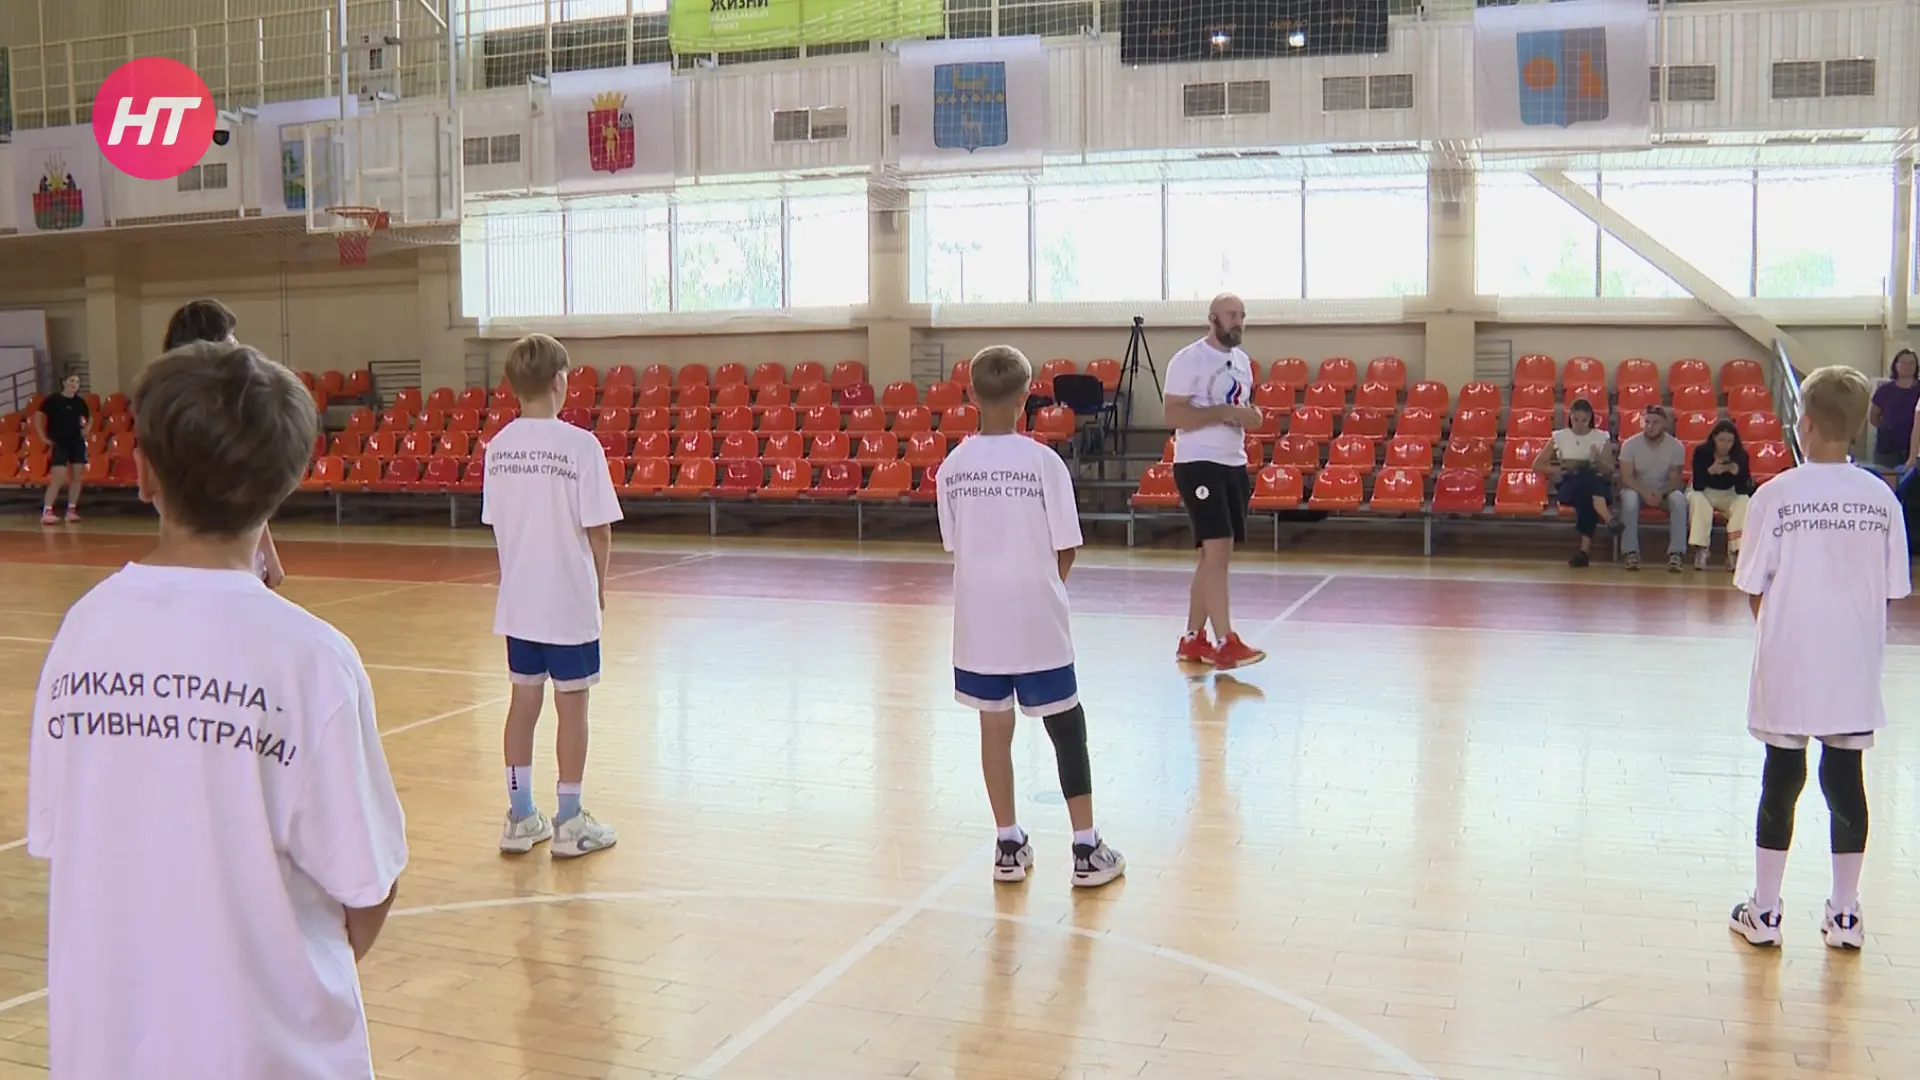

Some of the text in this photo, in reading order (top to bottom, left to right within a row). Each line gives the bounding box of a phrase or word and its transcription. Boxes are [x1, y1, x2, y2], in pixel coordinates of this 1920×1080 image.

[529, 451, 568, 464] СТРАНА
[991, 471, 1037, 482] СТРАНА
[1005, 487, 1044, 498] СТРАН
[153, 673, 268, 712] СТРАНА
[187, 716, 297, 767] СТРАНА!
